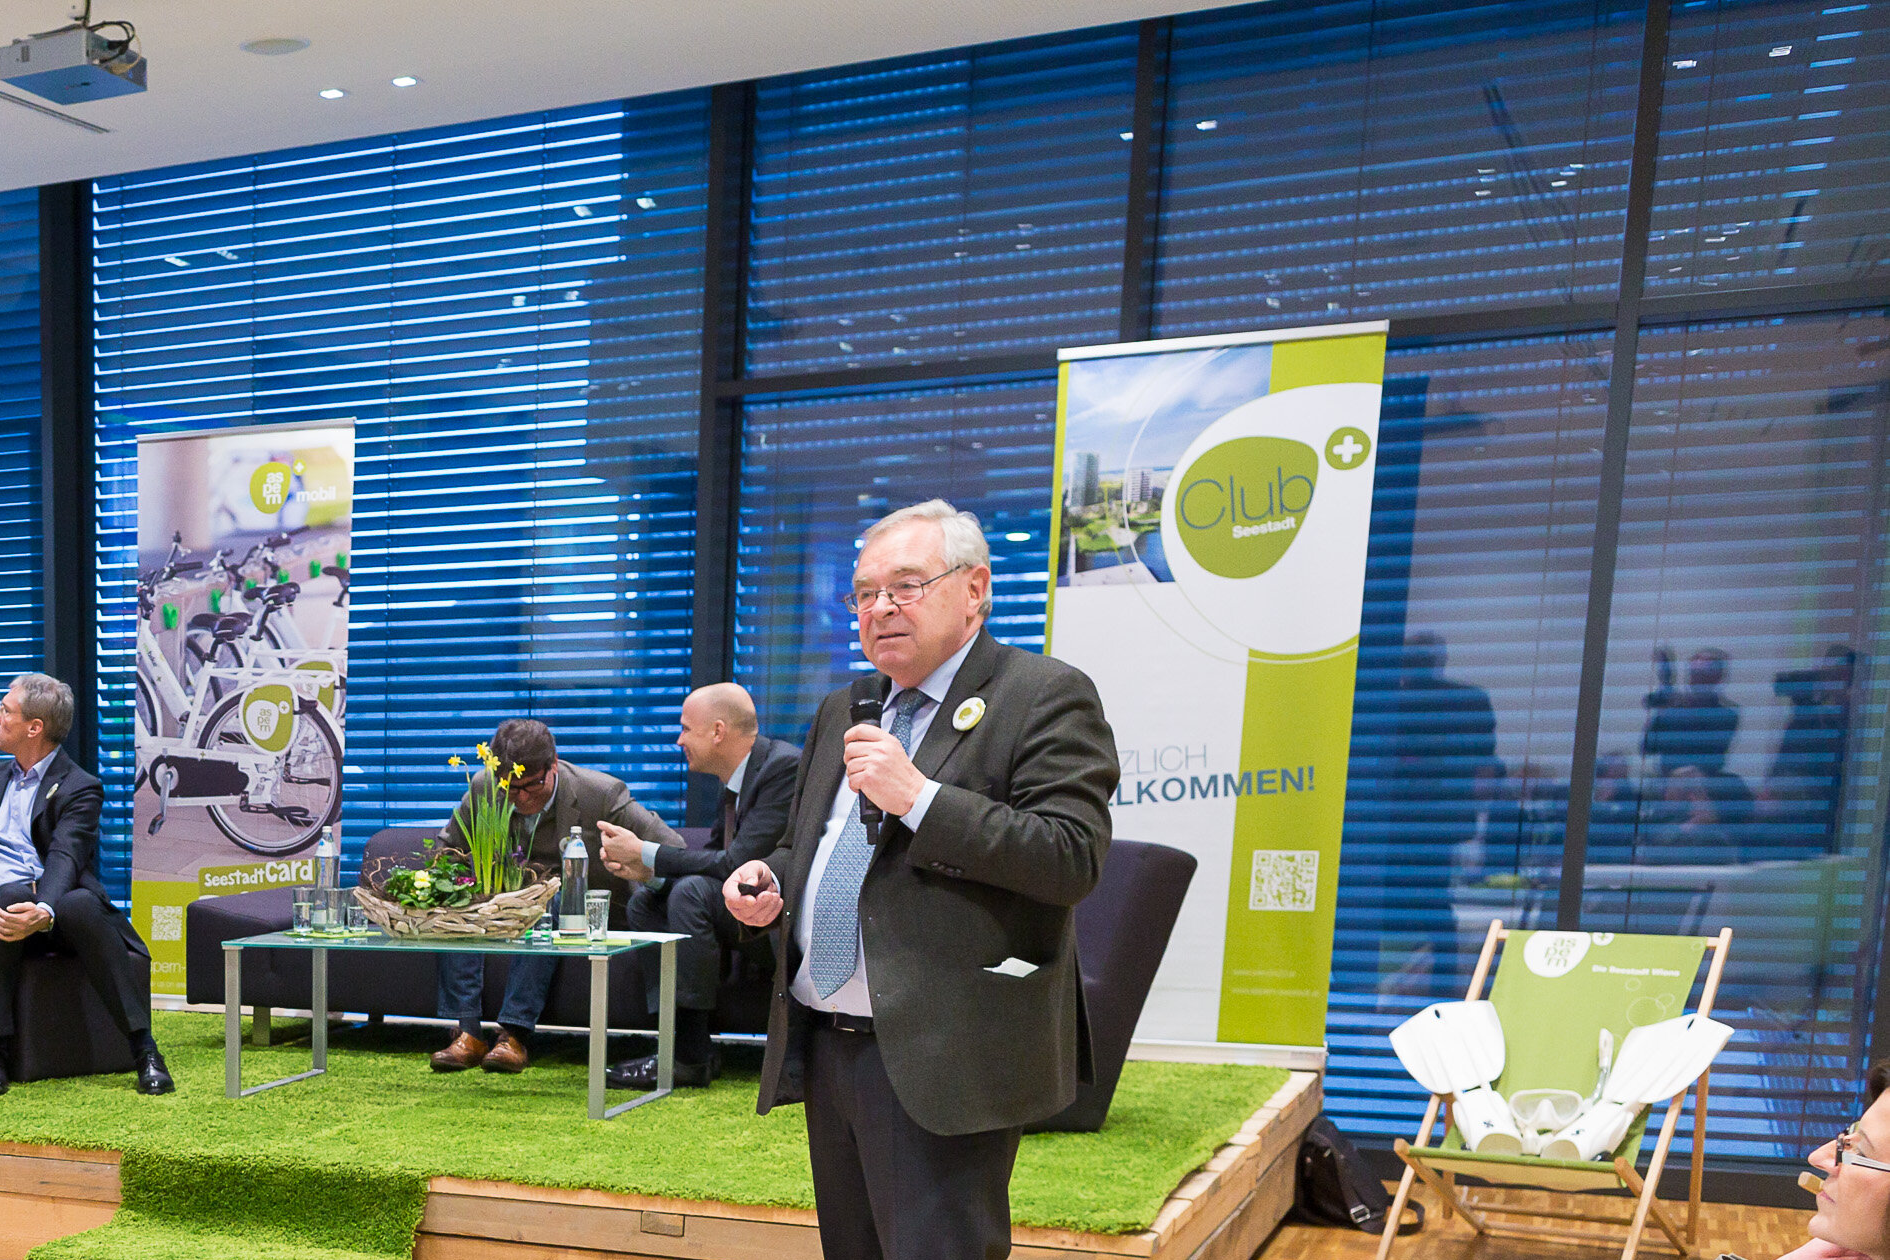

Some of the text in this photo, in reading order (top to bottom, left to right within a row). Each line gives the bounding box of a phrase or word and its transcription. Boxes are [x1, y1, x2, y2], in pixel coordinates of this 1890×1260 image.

[296, 486, 336, 502] mobil
[1180, 466, 1315, 529] Club
[1232, 516, 1296, 538] Seestadt
[1117, 744, 1207, 776] ZLICH
[1110, 765, 1315, 806] LKOMMEN!
